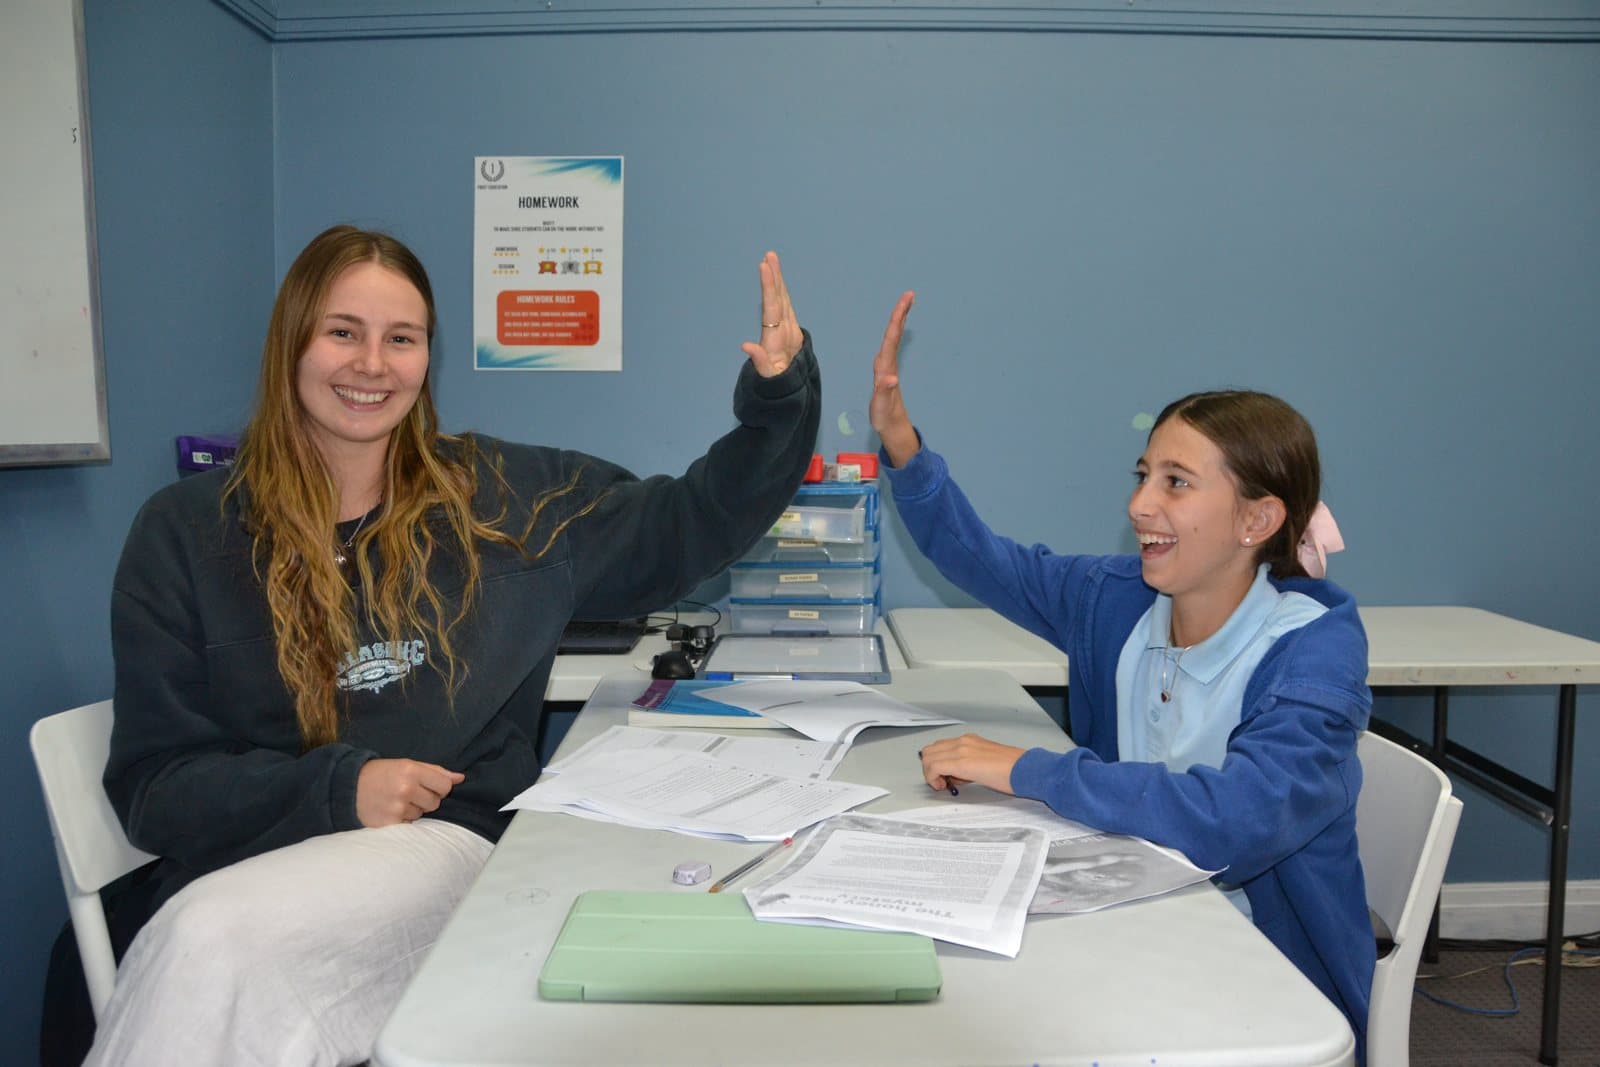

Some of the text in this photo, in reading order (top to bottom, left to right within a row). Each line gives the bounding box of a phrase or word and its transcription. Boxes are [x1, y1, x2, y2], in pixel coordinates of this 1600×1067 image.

[518, 196, 580, 209] HOMEWORK
[516, 296, 576, 304] HOMEWORK RULES
[837, 893, 924, 907] mystery
[842, 899, 908, 913] honey
[915, 906, 955, 919] The
